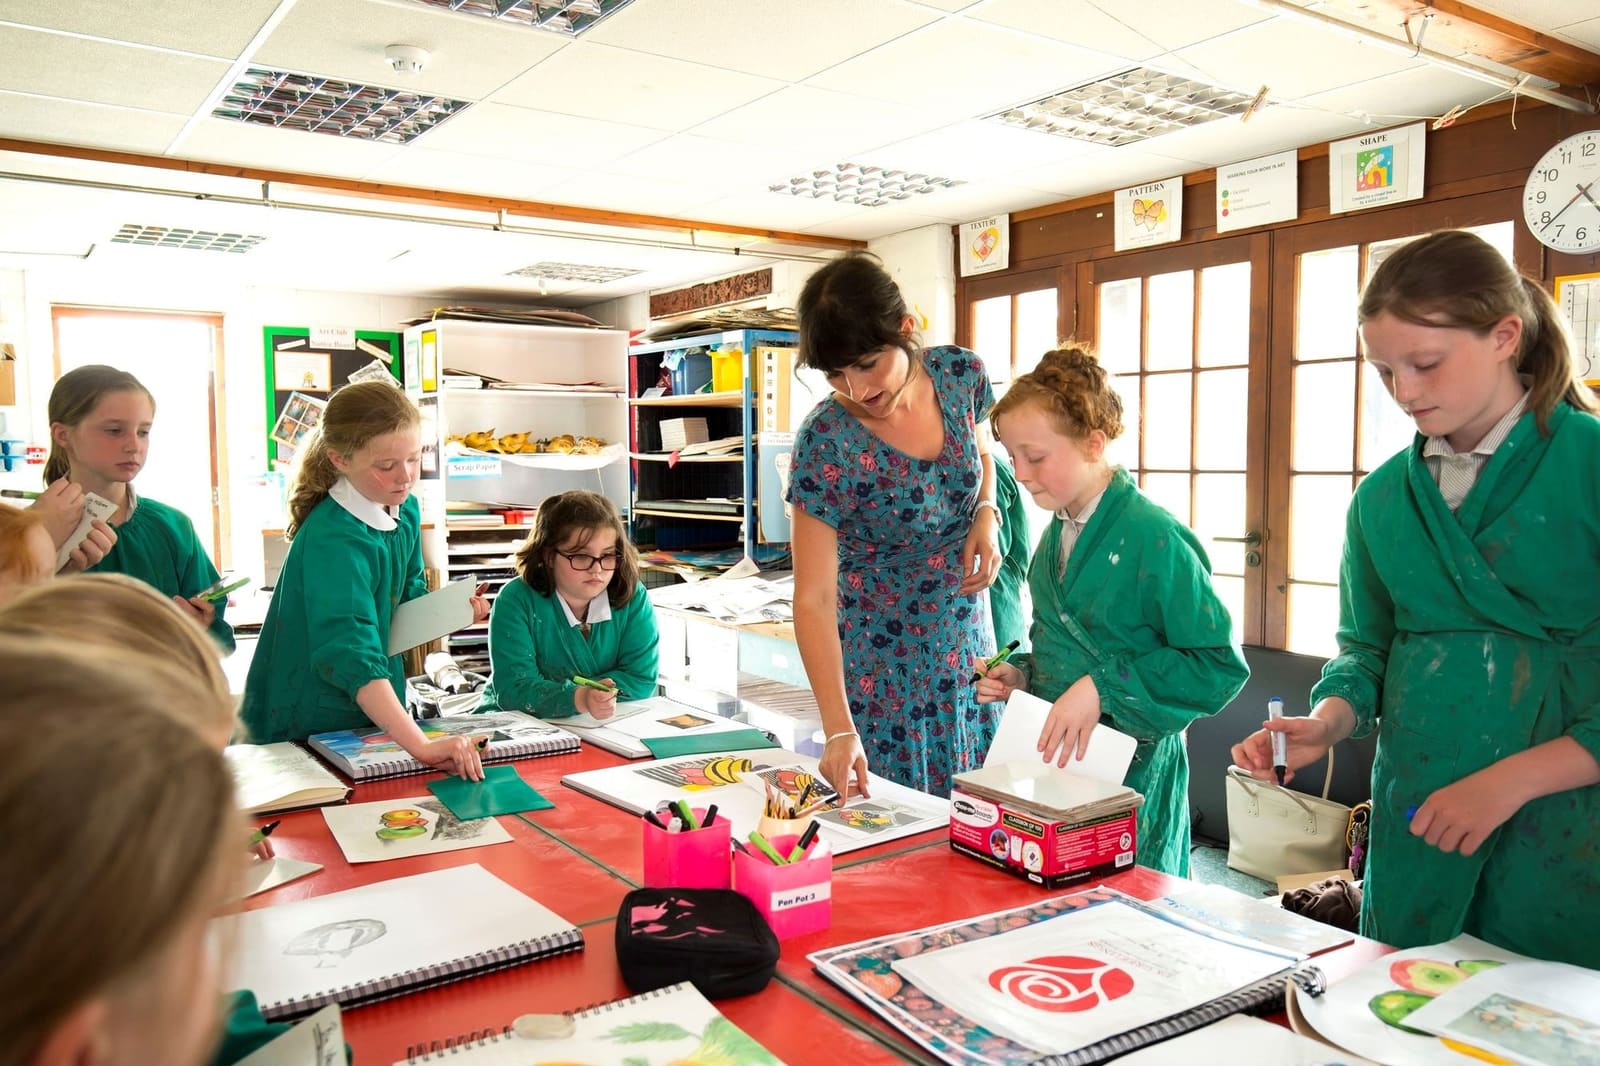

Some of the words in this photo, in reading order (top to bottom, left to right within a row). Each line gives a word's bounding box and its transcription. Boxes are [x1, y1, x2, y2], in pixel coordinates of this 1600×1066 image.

[1360, 134, 1388, 147] SHAPE
[1581, 143, 1596, 157] 12
[1561, 151, 1573, 165] 11
[1542, 168, 1559, 182] 10
[1129, 183, 1166, 197] PATTERN
[1536, 191, 1547, 204] 9
[1541, 211, 1551, 224] 8
[1555, 224, 1566, 237] 7
[1576, 227, 1587, 240] 6
[453, 463, 475, 472] Scrap
[476, 463, 496, 472] Paper
[777, 898, 793, 907] Pen
[795, 895, 808, 903] Pot
